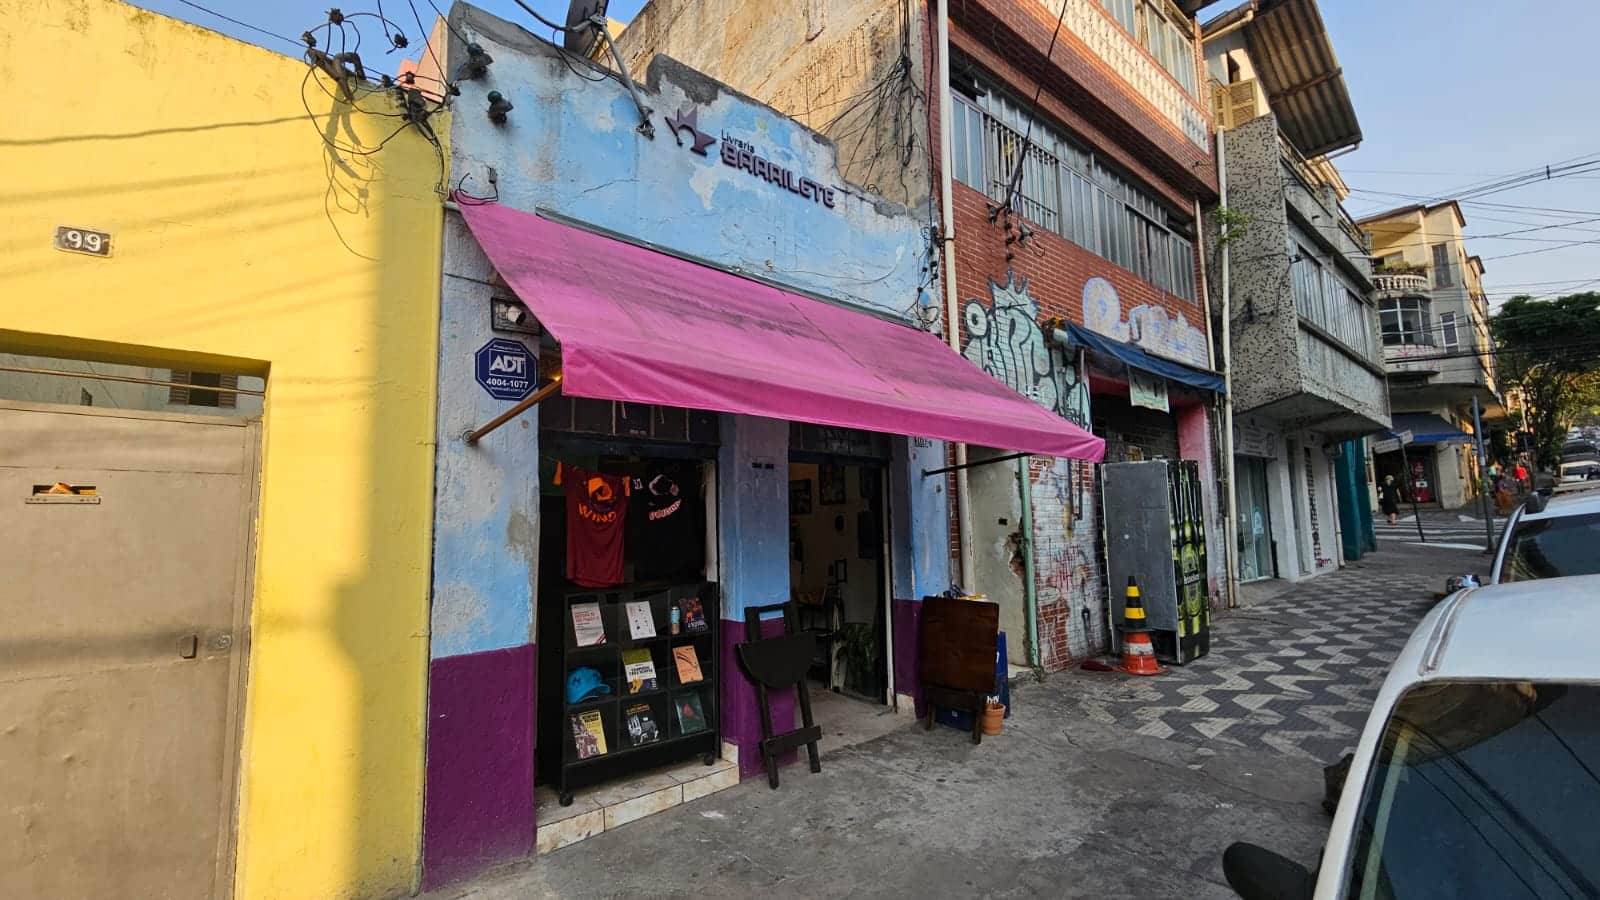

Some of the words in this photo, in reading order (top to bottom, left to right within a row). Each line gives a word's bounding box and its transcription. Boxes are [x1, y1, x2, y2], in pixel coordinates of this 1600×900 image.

[720, 129, 755, 154] Livraria
[720, 141, 836, 208] BARRILETE
[67, 230, 101, 252] 99
[490, 355, 526, 374] ADT
[486, 378, 529, 389] 4004-1077
